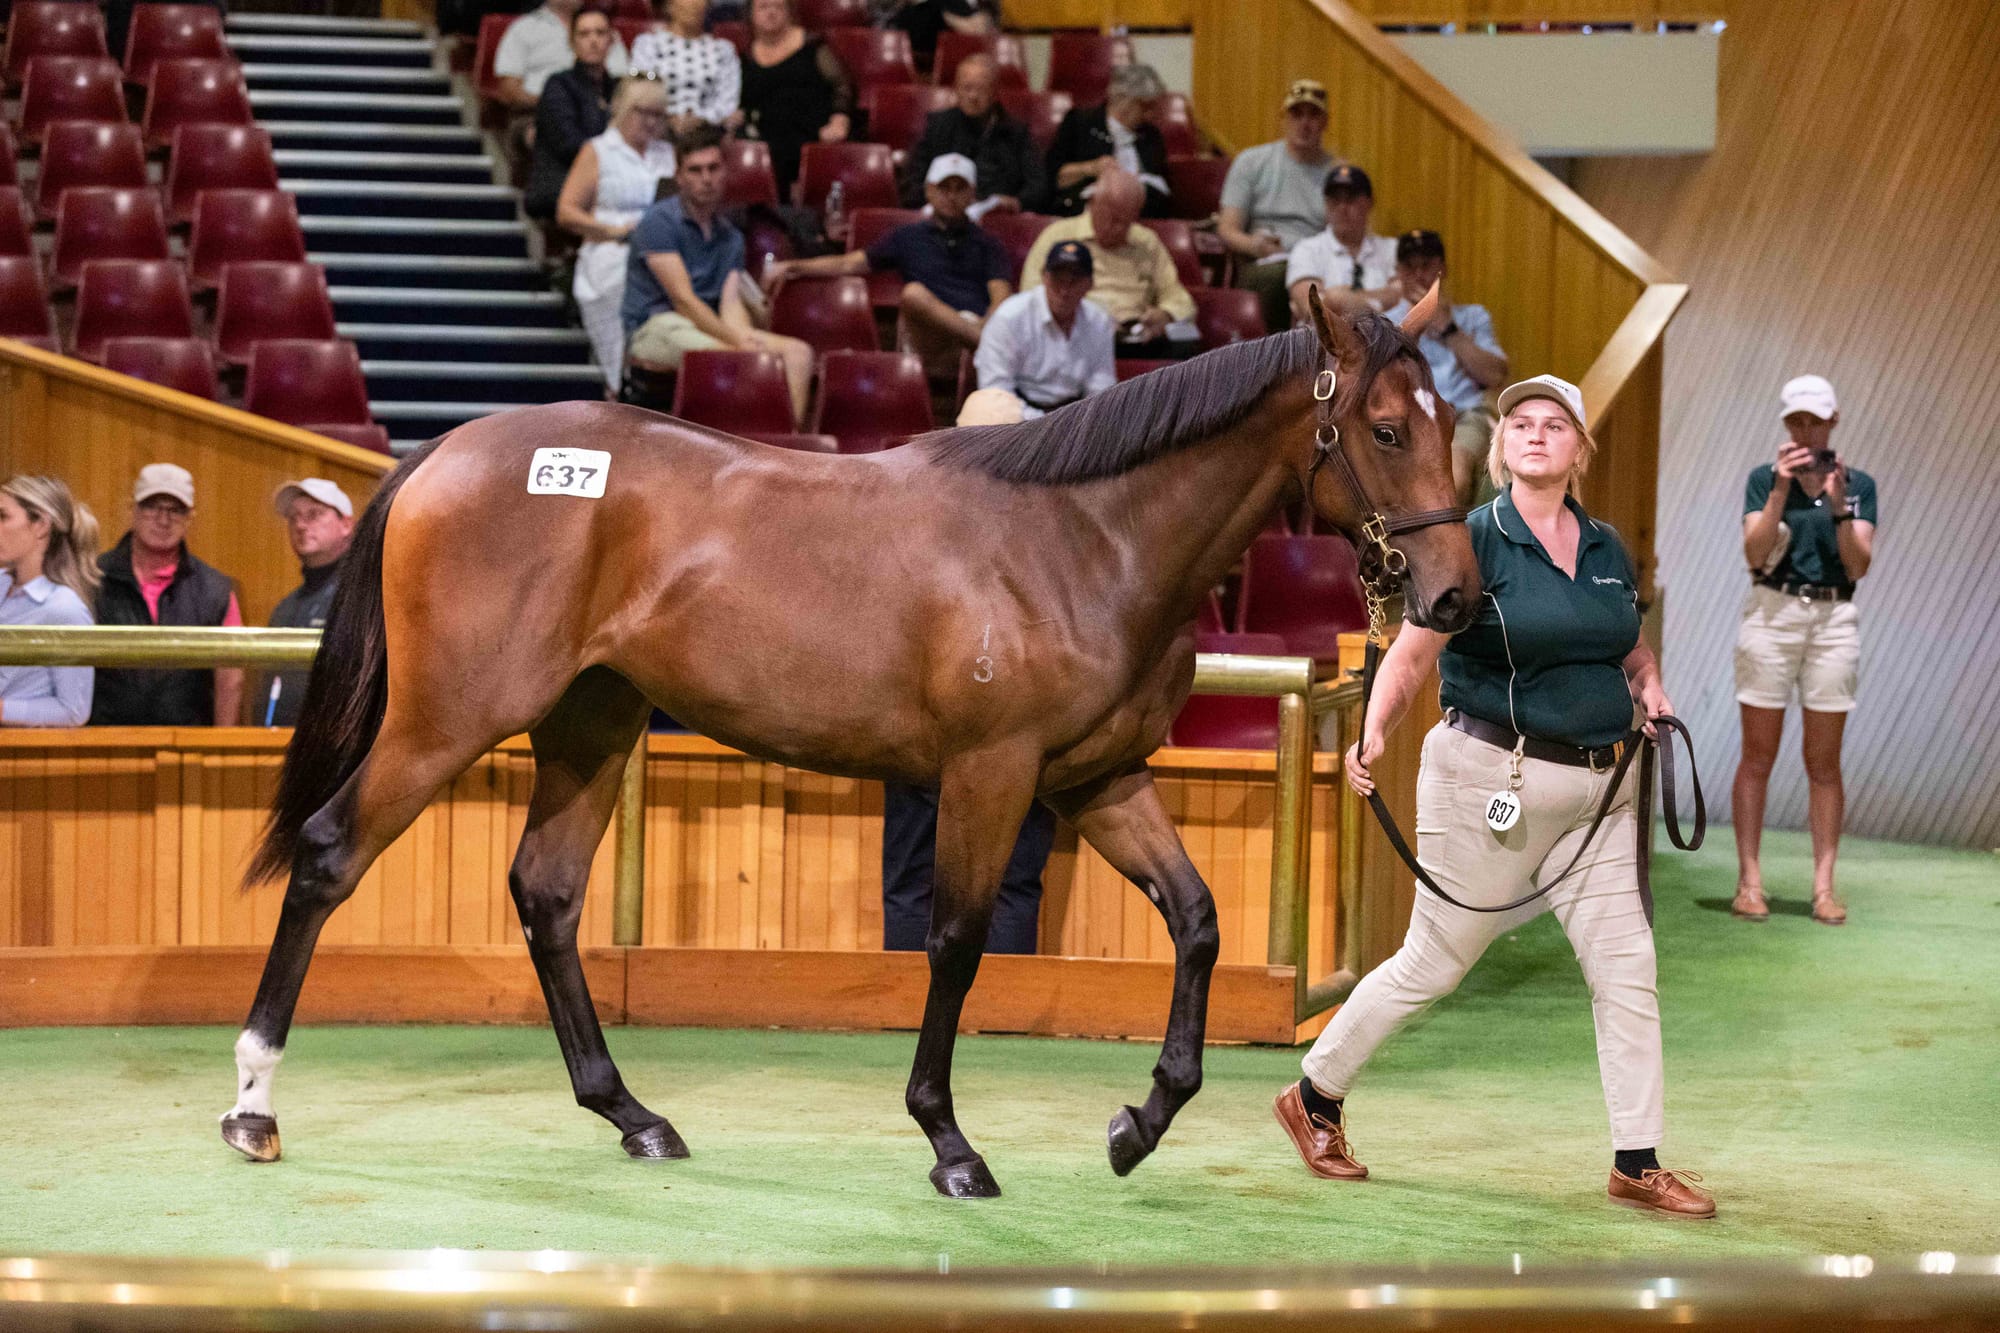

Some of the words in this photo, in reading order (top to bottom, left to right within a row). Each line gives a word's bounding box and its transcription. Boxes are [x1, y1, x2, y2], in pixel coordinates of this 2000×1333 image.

[536, 465, 598, 489] 637
[973, 655, 993, 683] 3
[1488, 799, 1515, 824] 637
